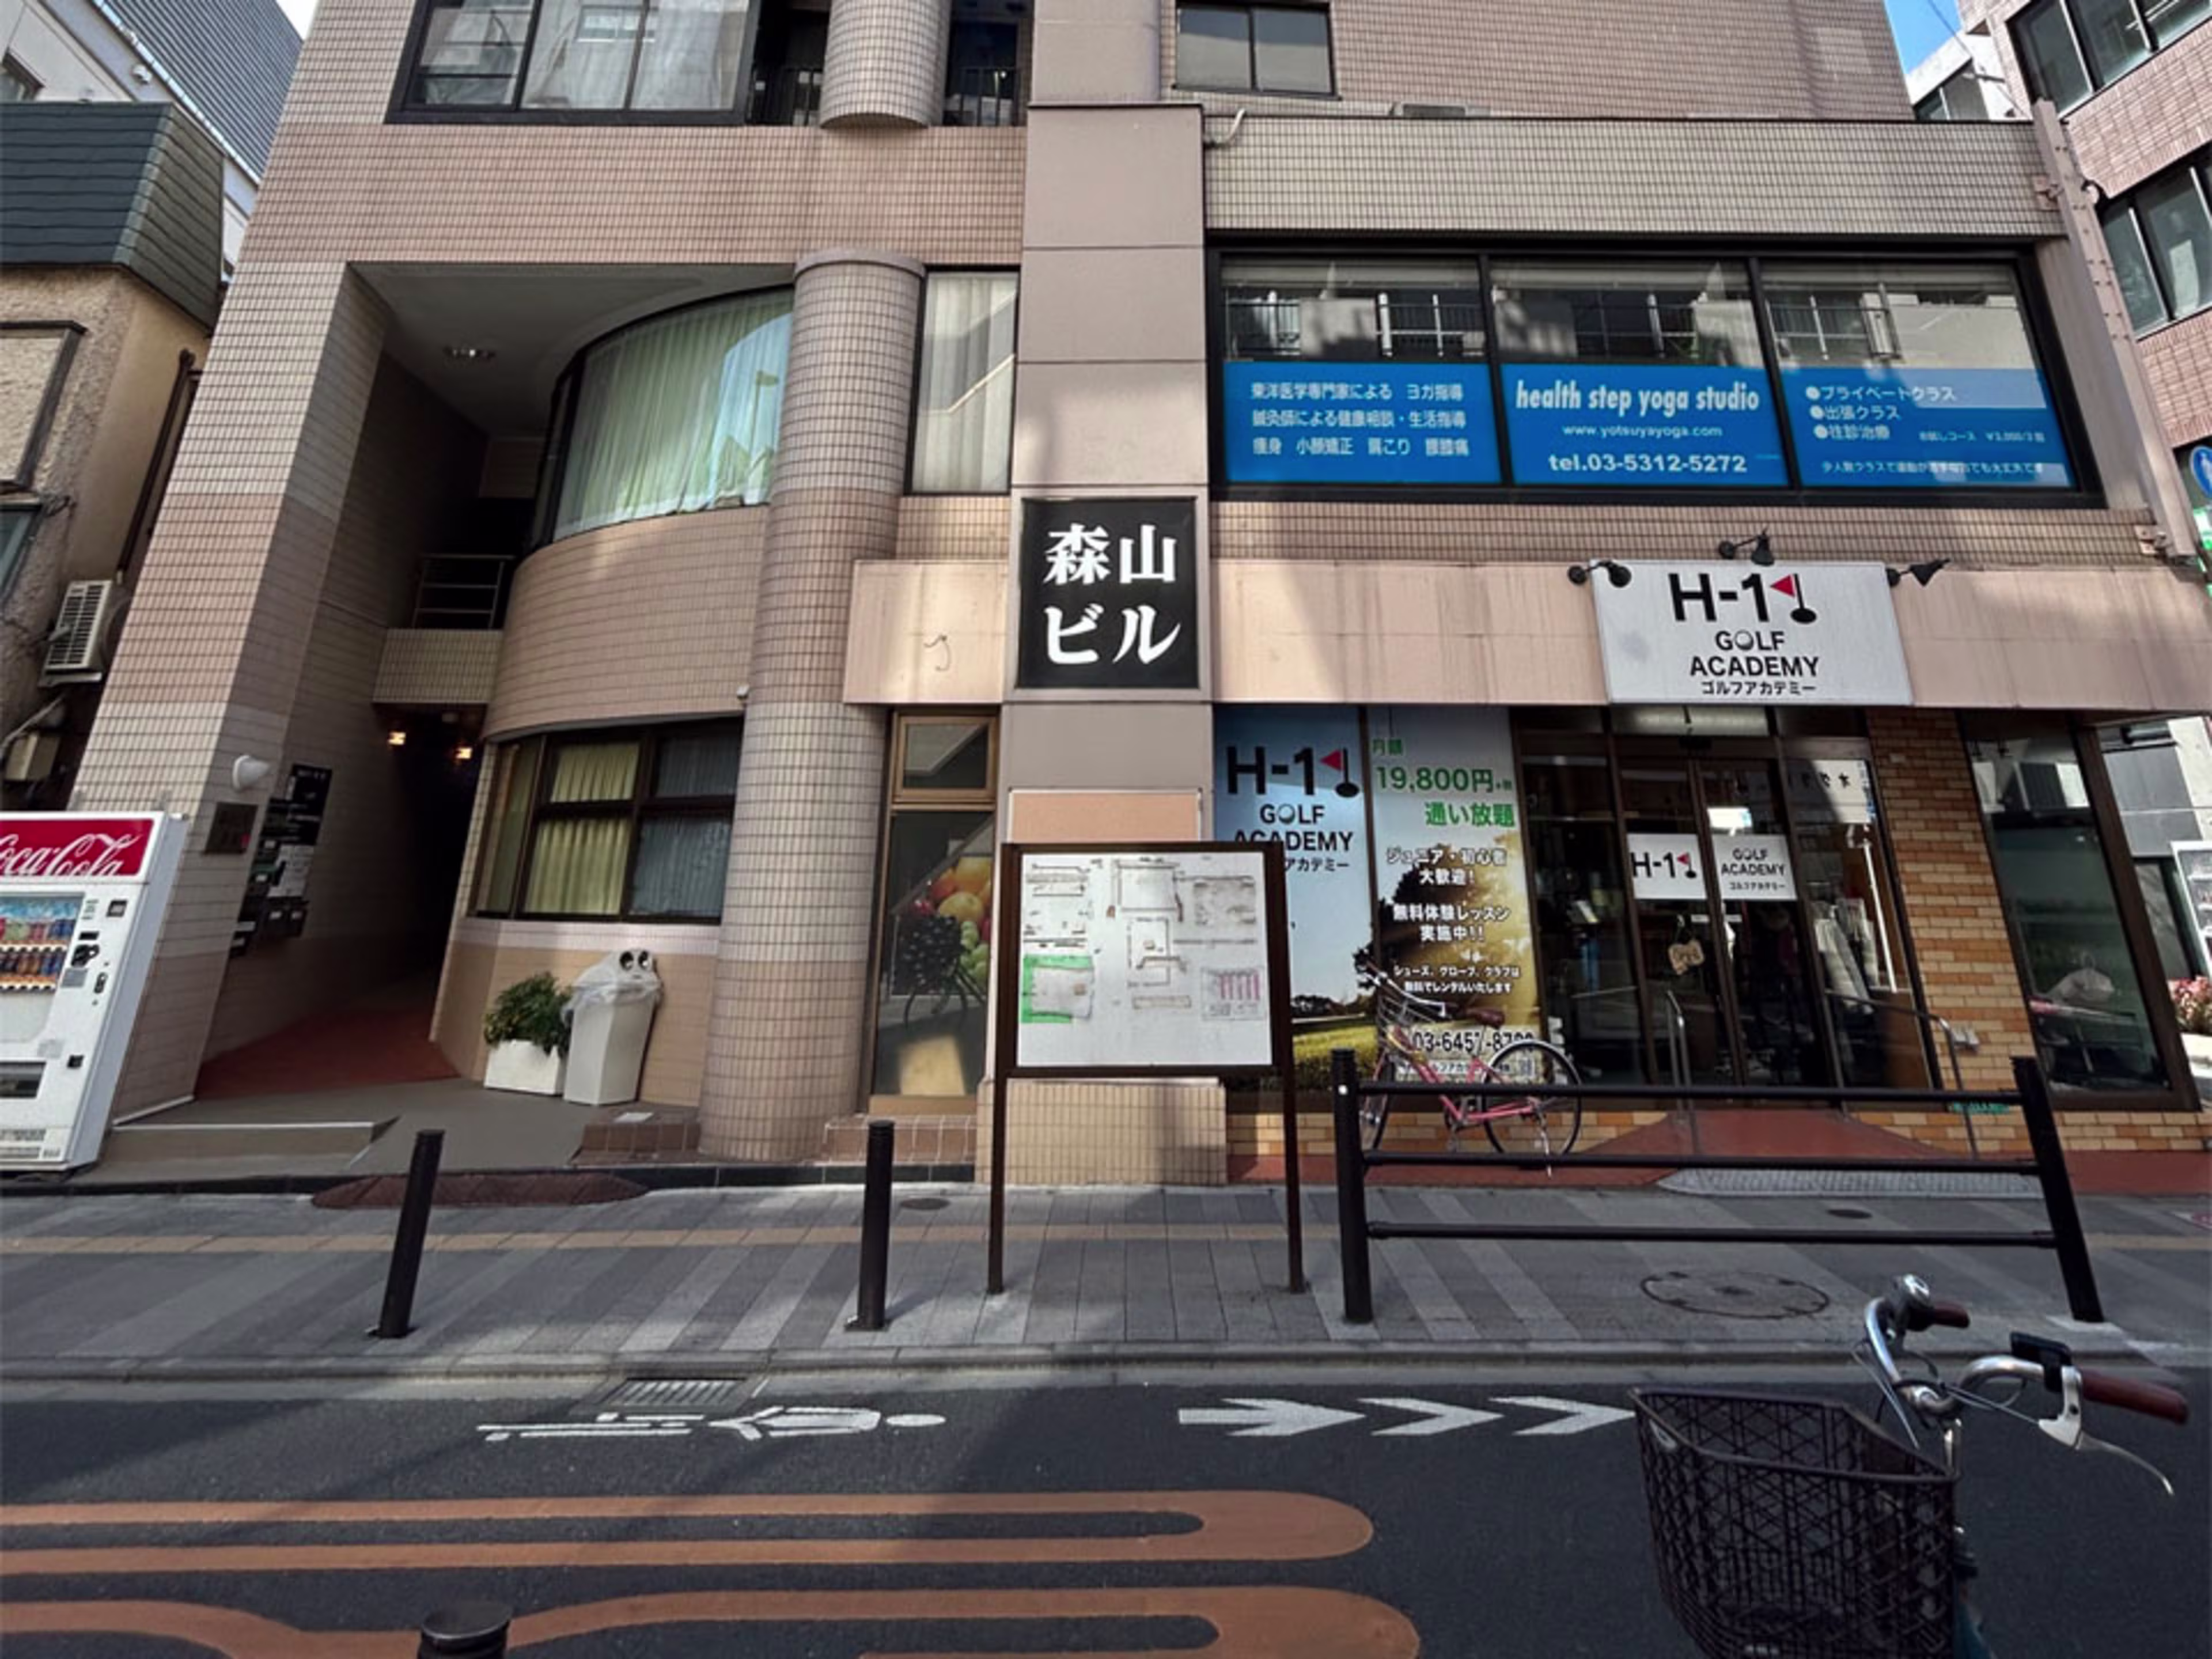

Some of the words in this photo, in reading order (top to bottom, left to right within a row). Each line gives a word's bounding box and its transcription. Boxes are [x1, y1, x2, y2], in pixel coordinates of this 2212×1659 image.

[1515, 379, 1582, 409] health
[1588, 382, 1632, 418] step
[1637, 388, 1689, 418] yoga
[1696, 381, 1760, 411] studio
[1562, 424, 1723, 439] www.yotsuyayoga.com
[1548, 453, 1748, 473] tel.03-5312-5272
[1043, 522, 1177, 585] 森山
[1668, 573, 1770, 623] H-1
[1043, 603, 1181, 664] ビル
[1715, 630, 1786, 652] GOLF
[1690, 656, 1820, 677] ACADEMY
[1701, 680, 1816, 696] ゴルフアカデミー
[1226, 745, 1316, 796] H-1
[1259, 804, 1325, 825] GOLF
[1425, 801, 1515, 828] 通い放題
[1732, 847, 1768, 861] GOLF
[1630, 852, 1676, 878] H-1
[1721, 863, 1785, 876] ACADEMY
[1392, 903, 1512, 922] 無料体験レッスン
